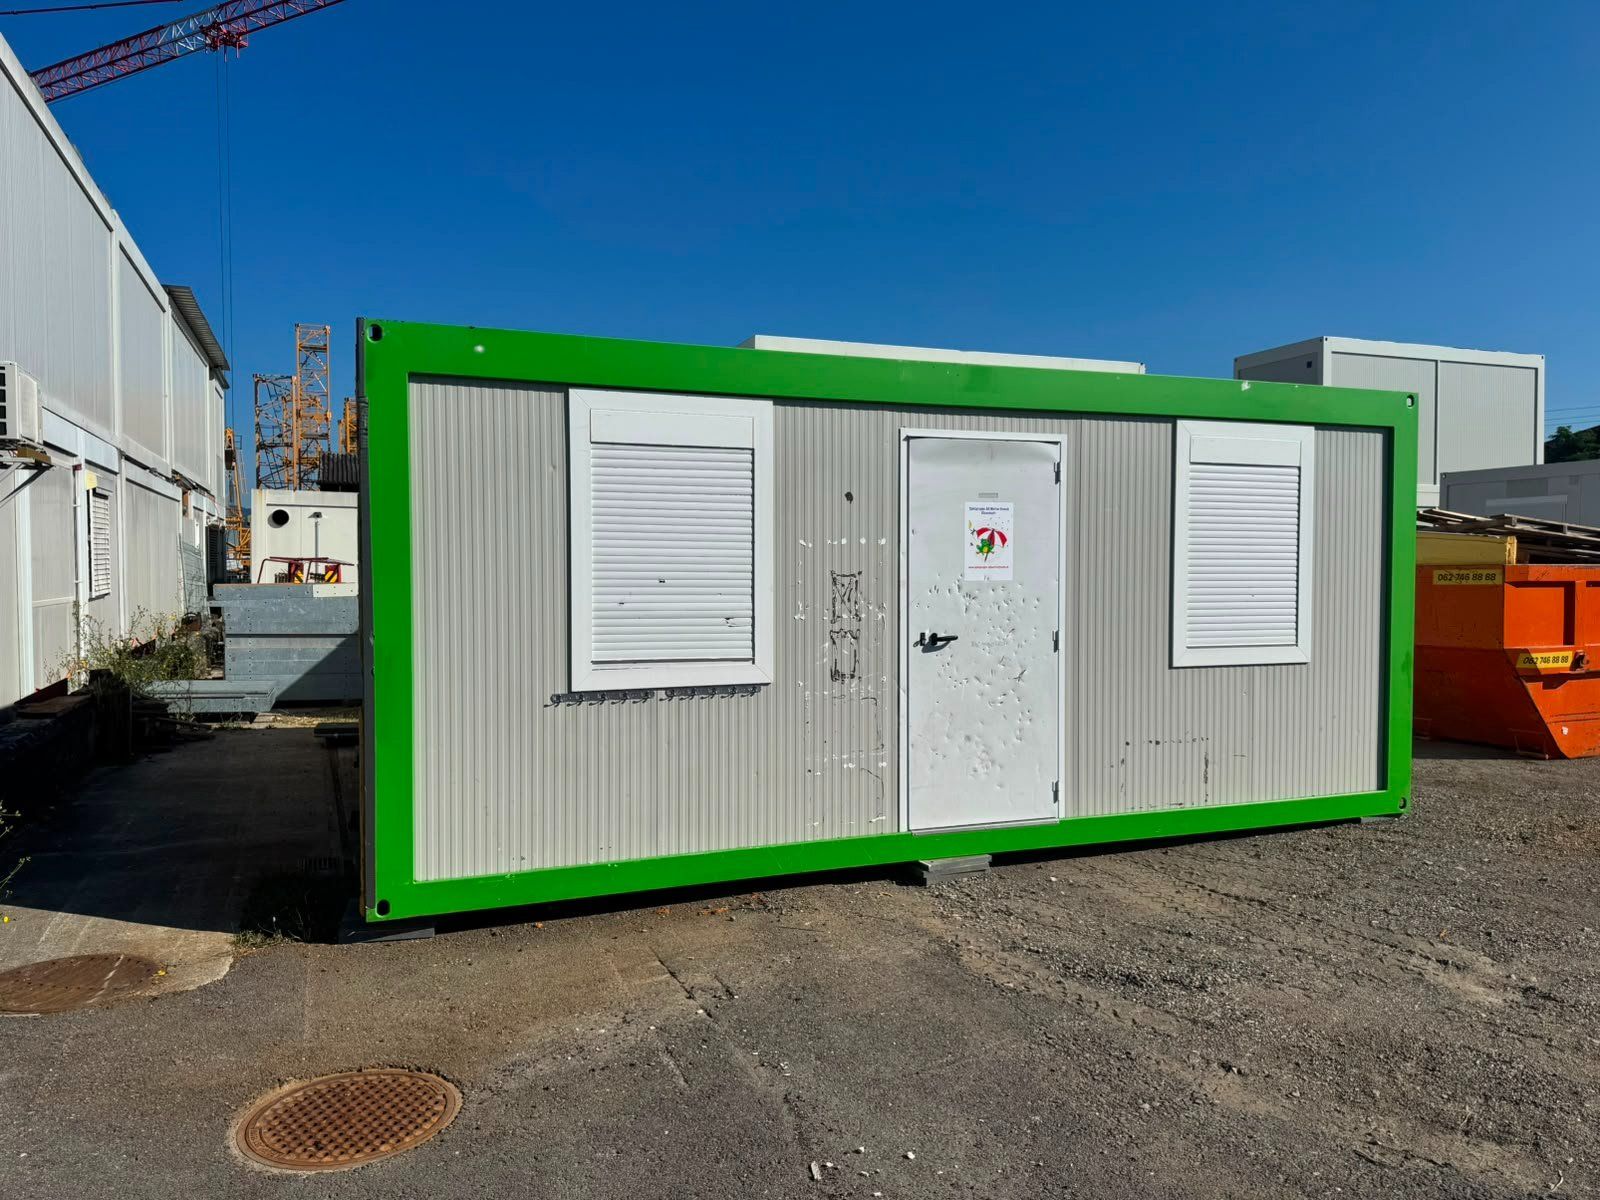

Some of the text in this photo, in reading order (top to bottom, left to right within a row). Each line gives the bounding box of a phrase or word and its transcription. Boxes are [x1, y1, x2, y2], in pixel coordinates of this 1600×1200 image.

[1437, 573, 1496, 581] 062 746 88 88
[1522, 655, 1569, 665] 062 746 88 88
